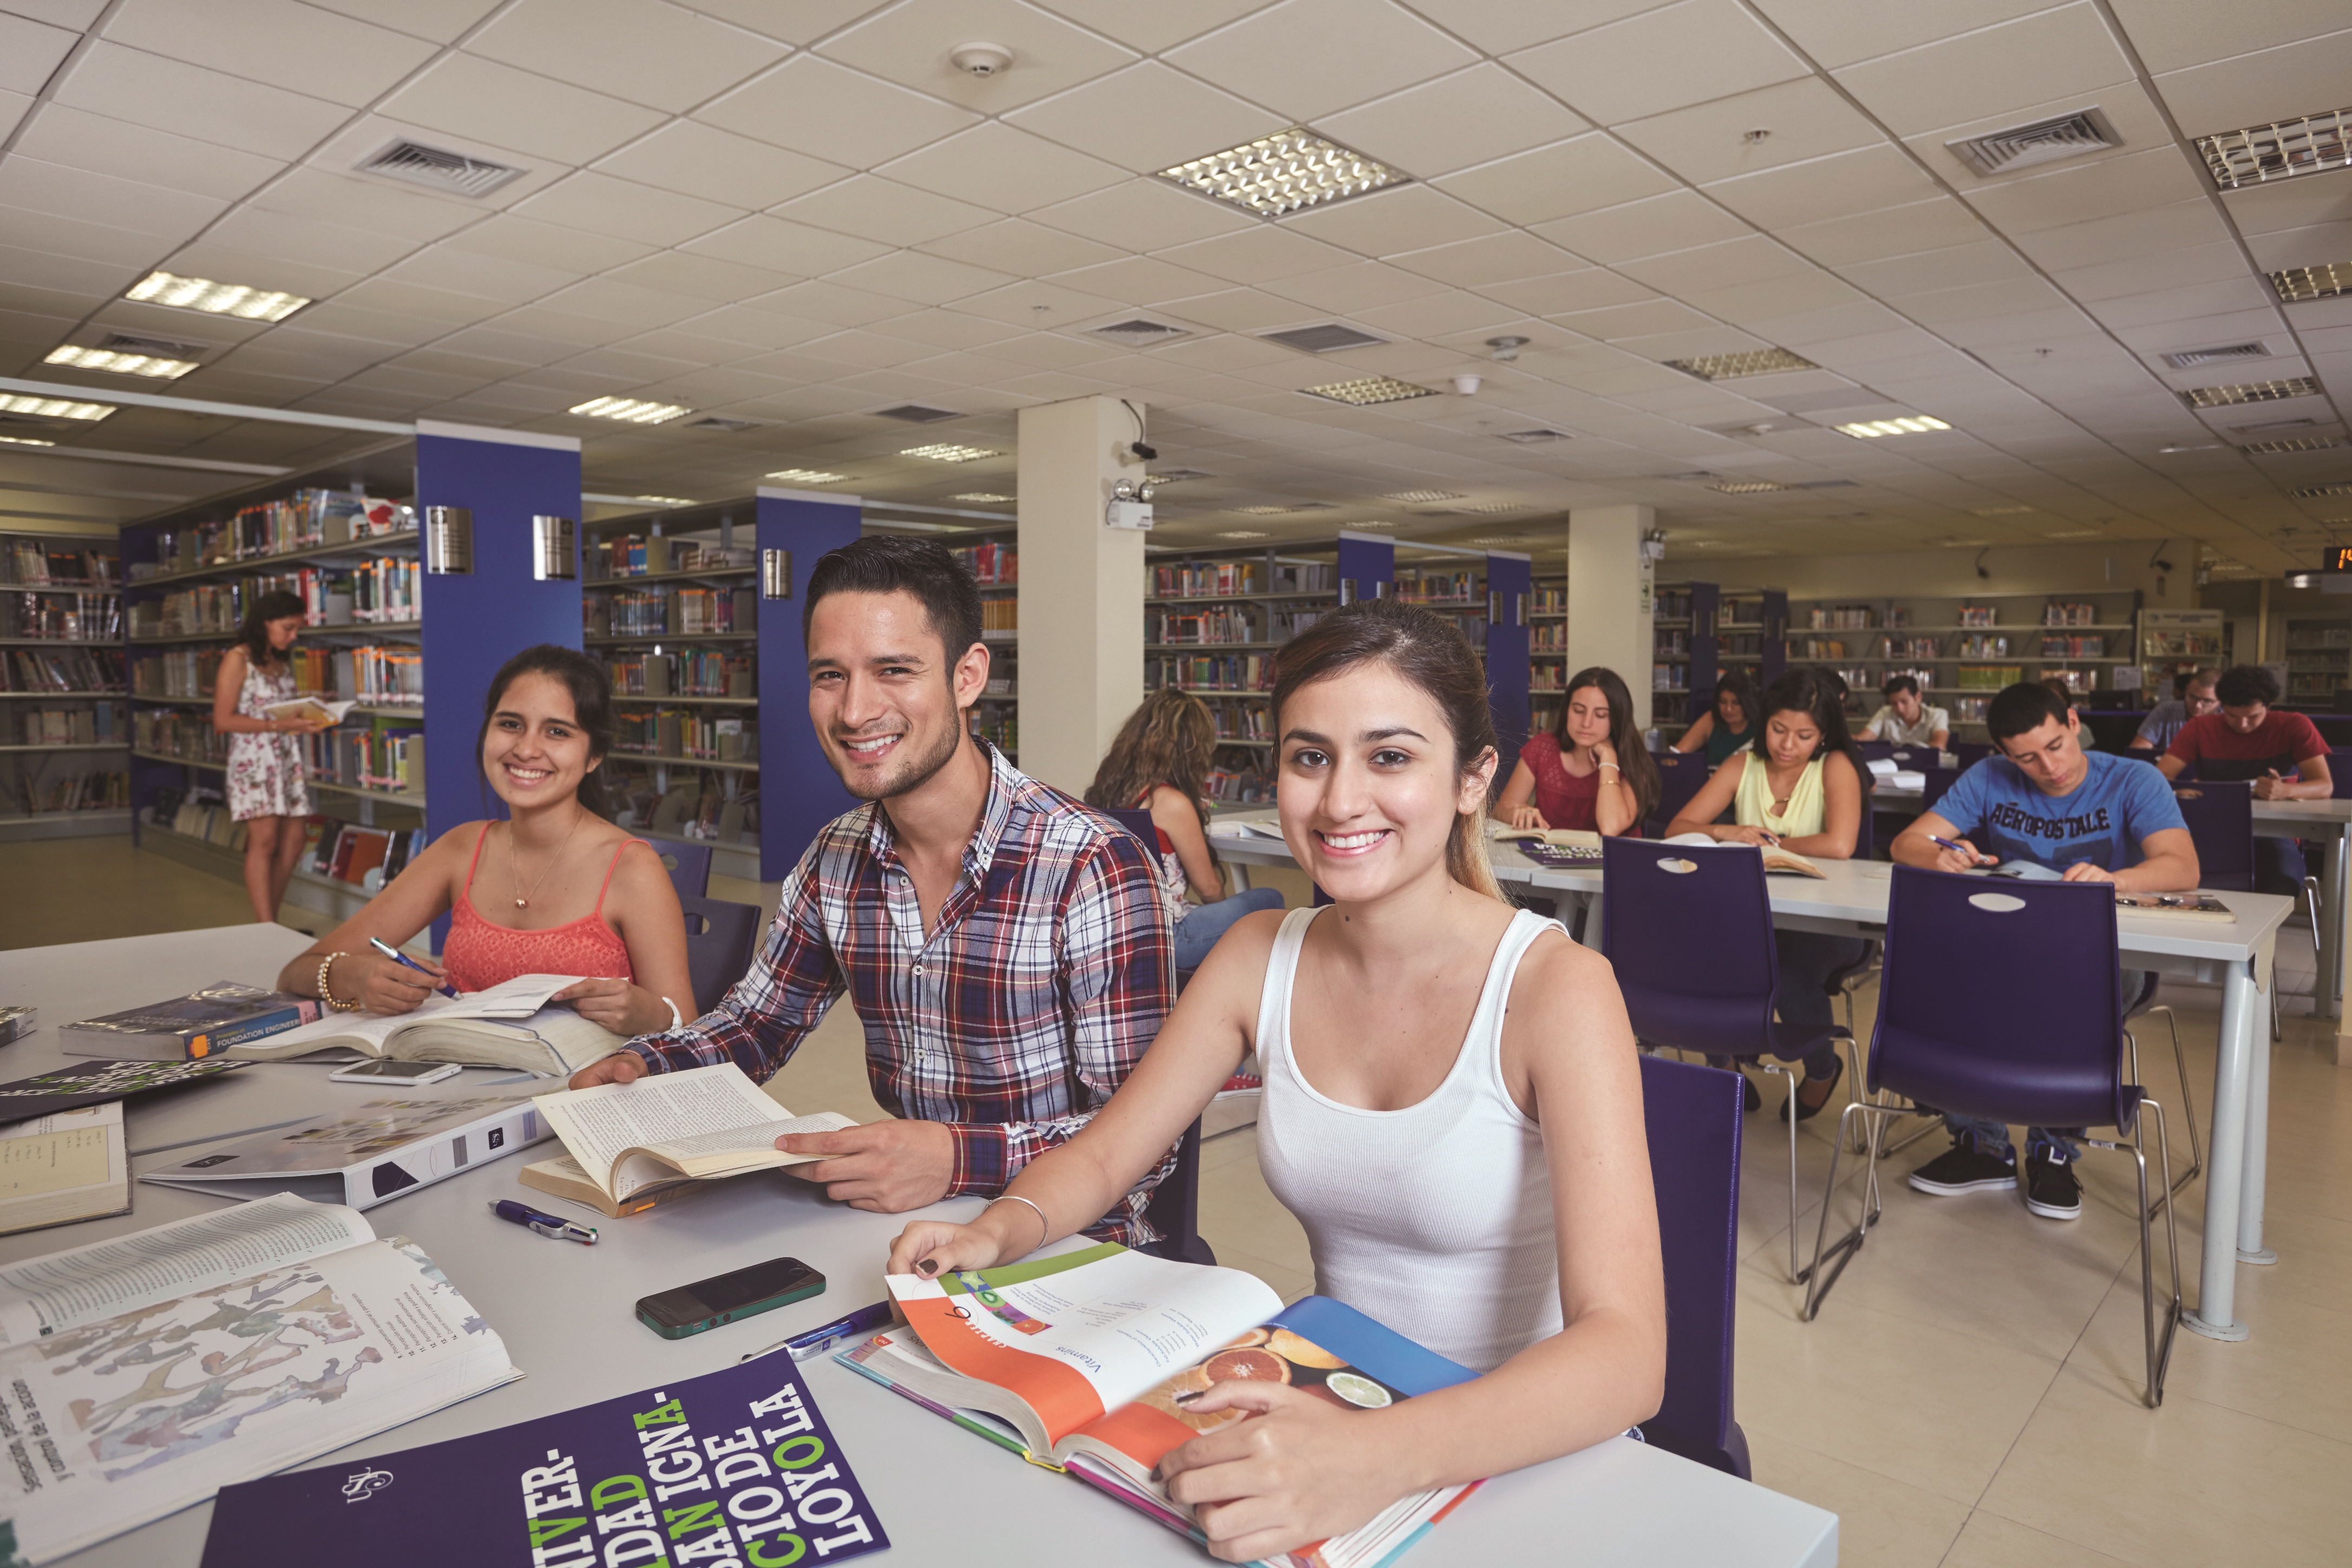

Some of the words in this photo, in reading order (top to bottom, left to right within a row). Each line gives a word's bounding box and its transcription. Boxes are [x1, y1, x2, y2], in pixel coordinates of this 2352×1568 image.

[217, 1029, 264, 1047] FOUNDATION
[102, 1061, 251, 1069] LOYOLA
[409, 1284, 421, 1295] motora
[351, 1293, 368, 1310] percepción
[402, 1292, 418, 1306] gustativa
[418, 1295, 434, 1310] cognición
[394, 1298, 417, 1324] somatosensorial
[415, 1309, 428, 1320] olfativa
[432, 1312, 443, 1322] motor
[944, 1306, 971, 1319] 6
[365, 1314, 381, 1328] sensorial
[385, 1321, 396, 1331] visual
[394, 1315, 407, 1327] auditiva
[424, 1320, 443, 1337] Percepción
[440, 1322, 453, 1334] Control
[393, 1331, 410, 1349] Percepción
[403, 1328, 421, 1345] Percepción
[414, 1324, 432, 1341] Percepción
[965, 1321, 1008, 1349] CHAPTER
[1136, 1329, 1151, 1341] Vitamins
[1175, 1333, 1186, 1347] Vitamin
[1177, 1321, 1199, 1348] Water-Soluble
[1189, 1327, 1200, 1340] Vitamin
[377, 1329, 399, 1353] Procesamiento
[1160, 1342, 1171, 1355] Vitamin
[1165, 1338, 1175, 1353] Vitamin
[1170, 1336, 1181, 1350] Vitamin
[1055, 1346, 1101, 1373] Vitamins
[1137, 1338, 1161, 1367] Characteristics
[1151, 1340, 1170, 1363] Fat-Soluble
[633, 1391, 711, 1502] IGNA-
[703, 1426, 772, 1488] DE
[749, 1382, 873, 1557] LOYOLA
[728, 1486, 807, 1568] CIO
